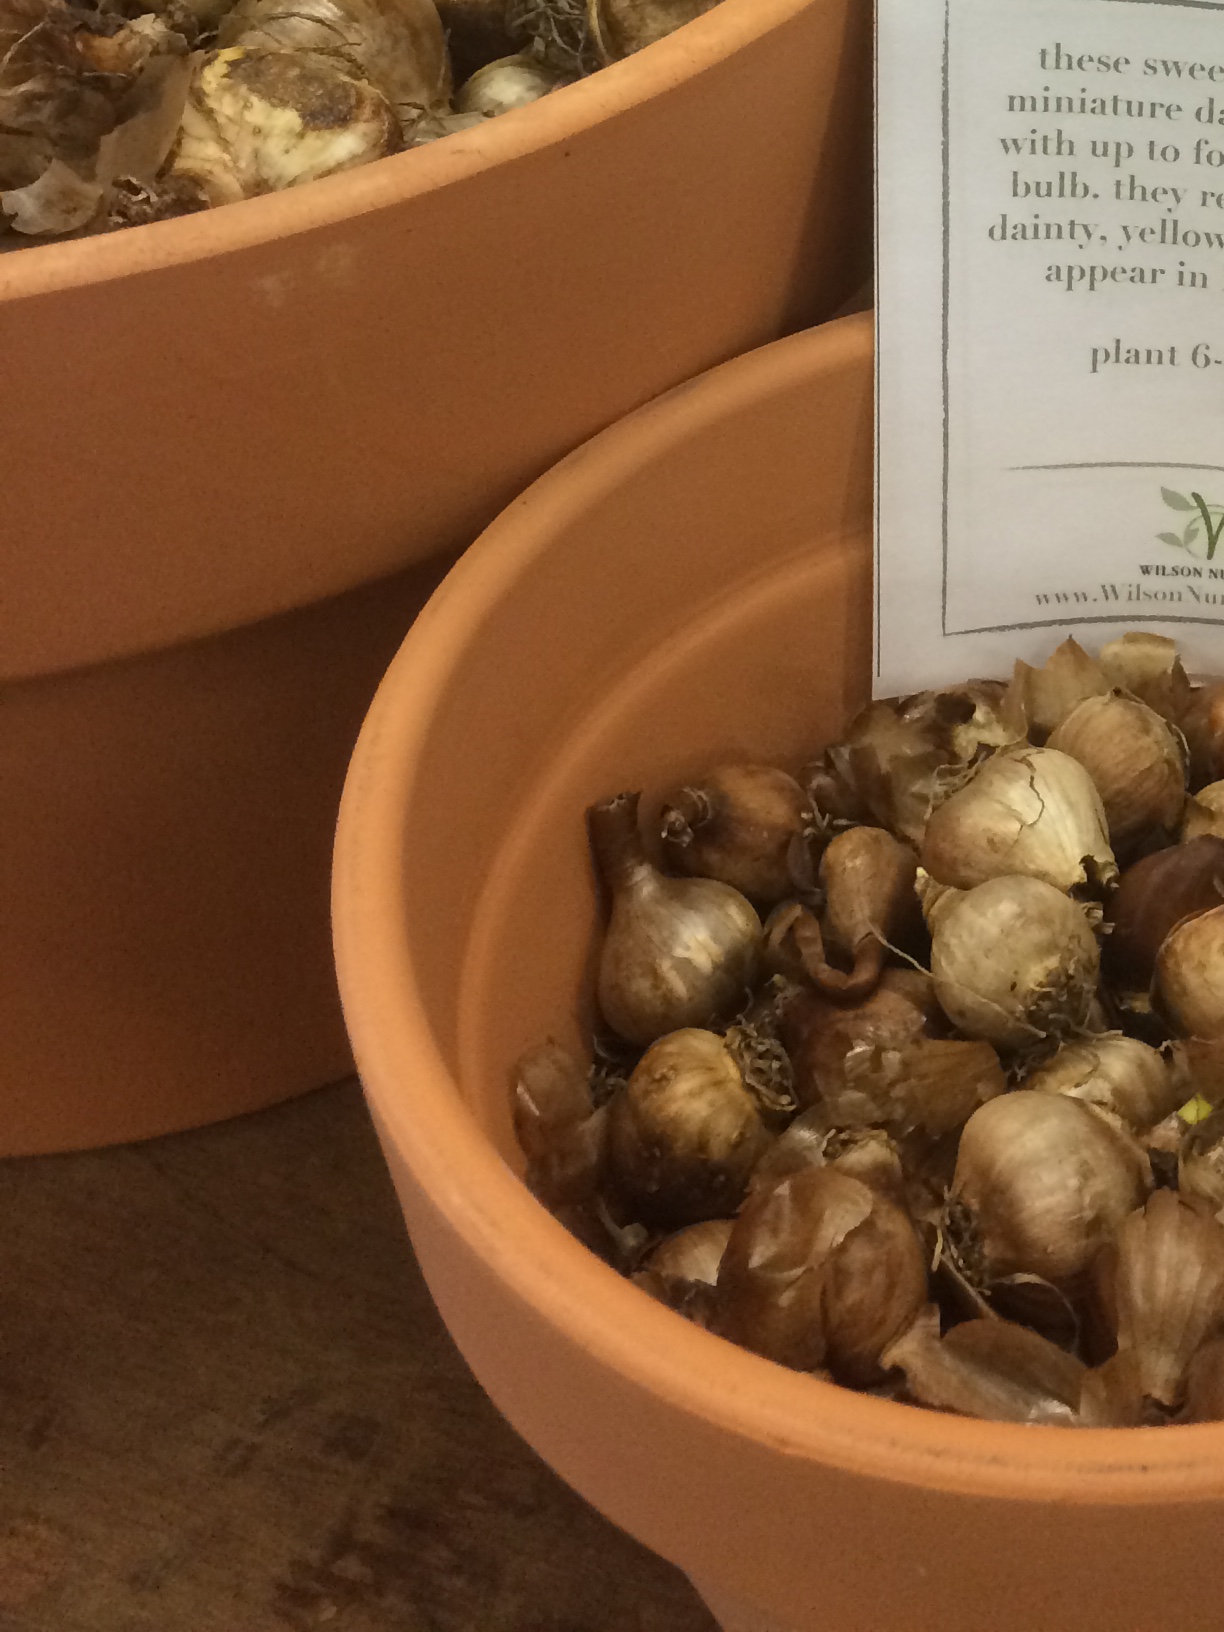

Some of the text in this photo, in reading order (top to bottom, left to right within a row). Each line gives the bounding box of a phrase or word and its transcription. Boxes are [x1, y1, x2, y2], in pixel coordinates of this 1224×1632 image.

[1038, 43, 1132, 75] these
[1007, 86, 1183, 123] miniature
[1000, 128, 1076, 158] with
[1090, 139, 1135, 167] up
[1148, 139, 1182, 165] to
[1010, 172, 1100, 202] bulb.
[1113, 177, 1188, 213] they
[987, 214, 1108, 249] dainty,
[1045, 261, 1166, 291] appear
[1177, 261, 1209, 289] in
[1090, 340, 1179, 374] plant
[1139, 564, 1202, 578] WILSON
